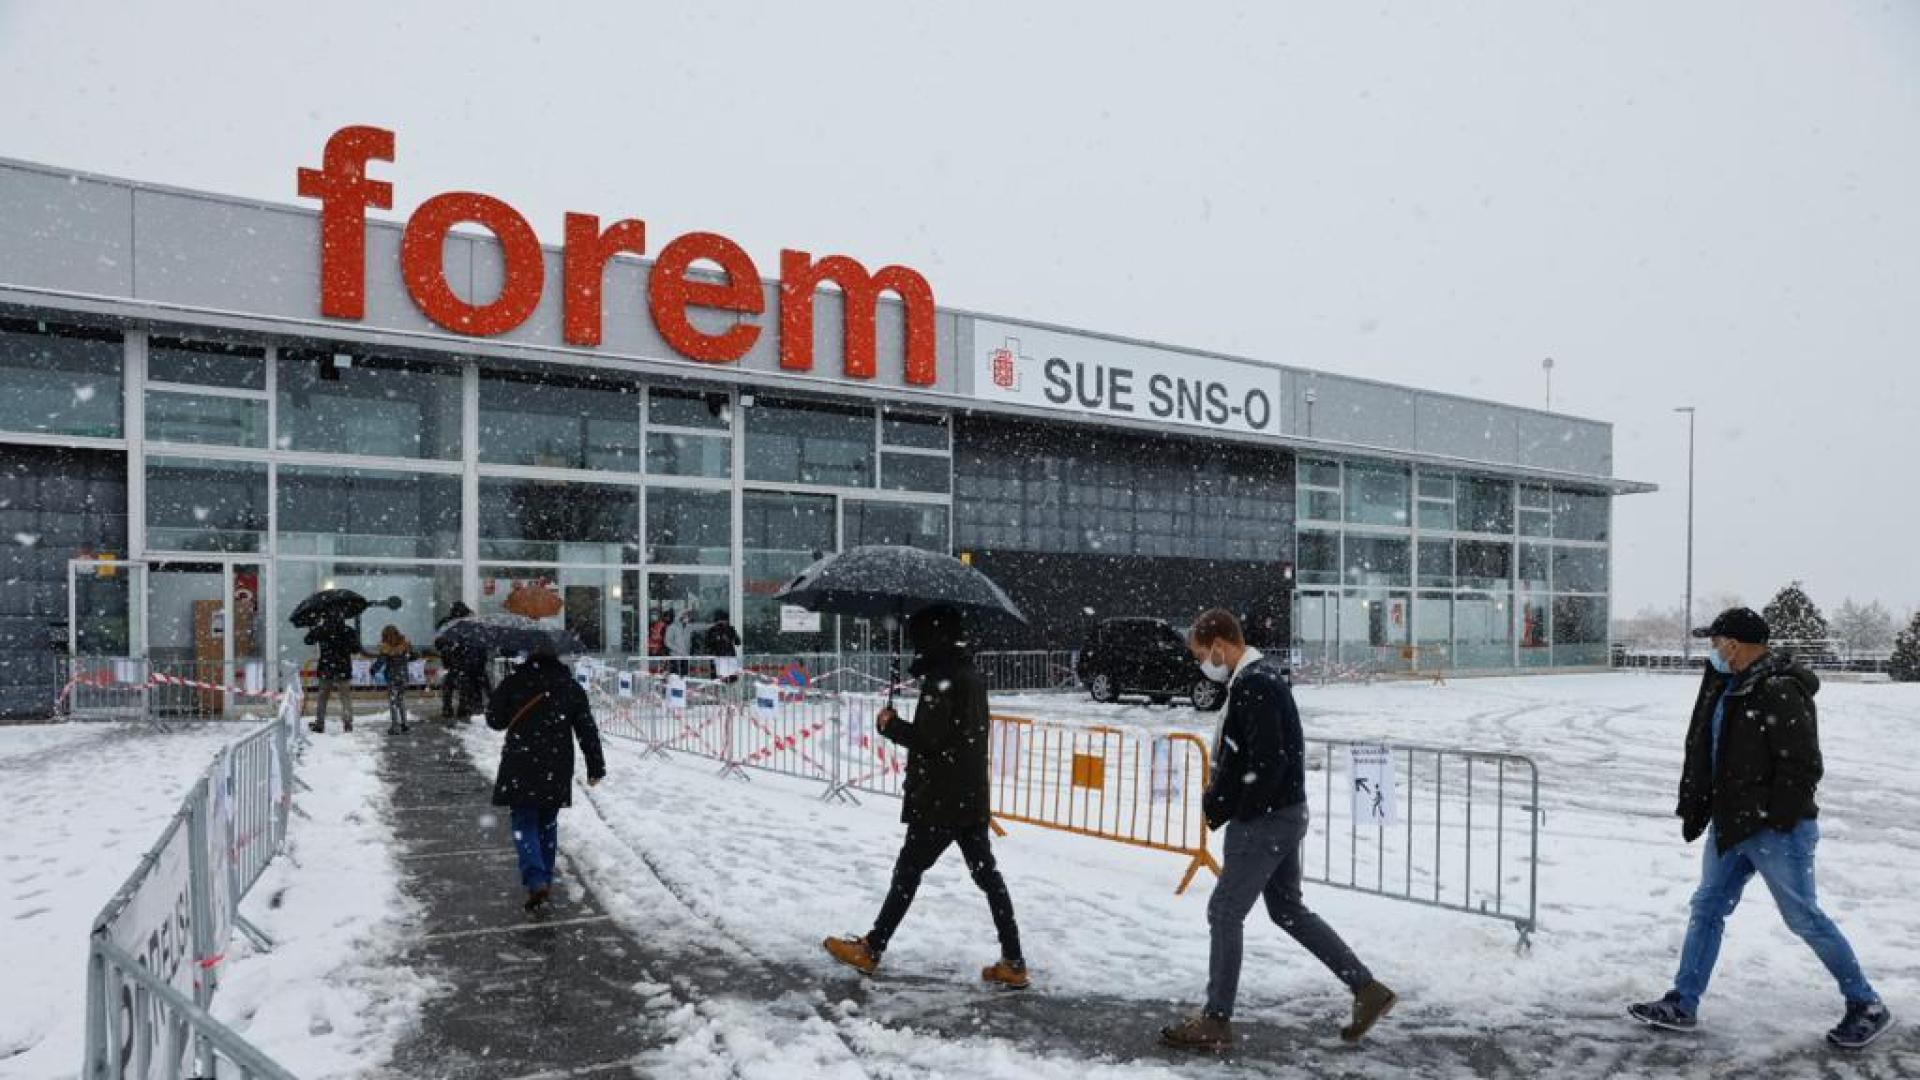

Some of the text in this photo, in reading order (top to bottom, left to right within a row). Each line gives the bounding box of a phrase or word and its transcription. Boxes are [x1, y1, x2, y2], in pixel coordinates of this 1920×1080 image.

[298, 125, 936, 385] forem
[1043, 357, 1270, 429] SUE SNS-O
